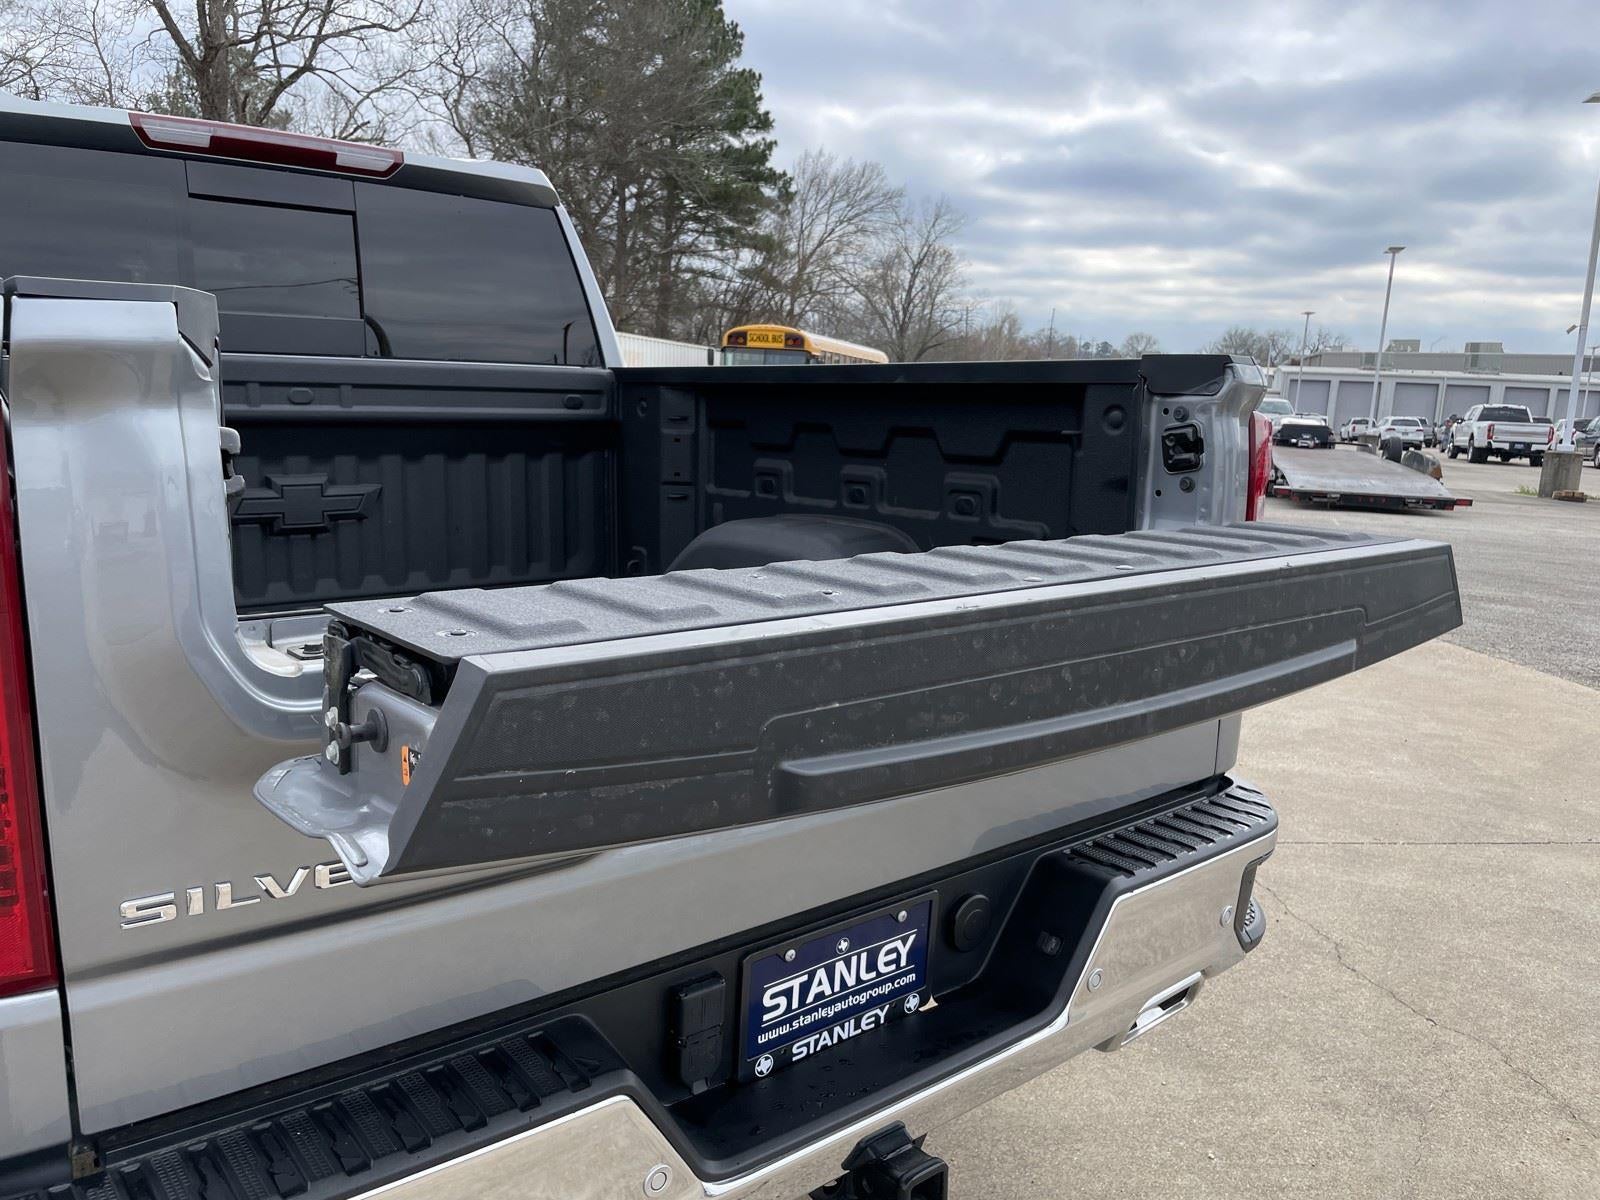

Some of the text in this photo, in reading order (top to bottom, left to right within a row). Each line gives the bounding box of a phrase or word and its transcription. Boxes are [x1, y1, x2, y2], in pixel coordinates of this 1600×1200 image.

[749, 333, 783, 343] SCHOOL BUS
[119, 859, 354, 930] SILVE
[757, 972, 916, 1044] www.stanleyautogroup.com
[762, 933, 917, 1022] STANLEY
[791, 1004, 889, 1062] STANLEY
